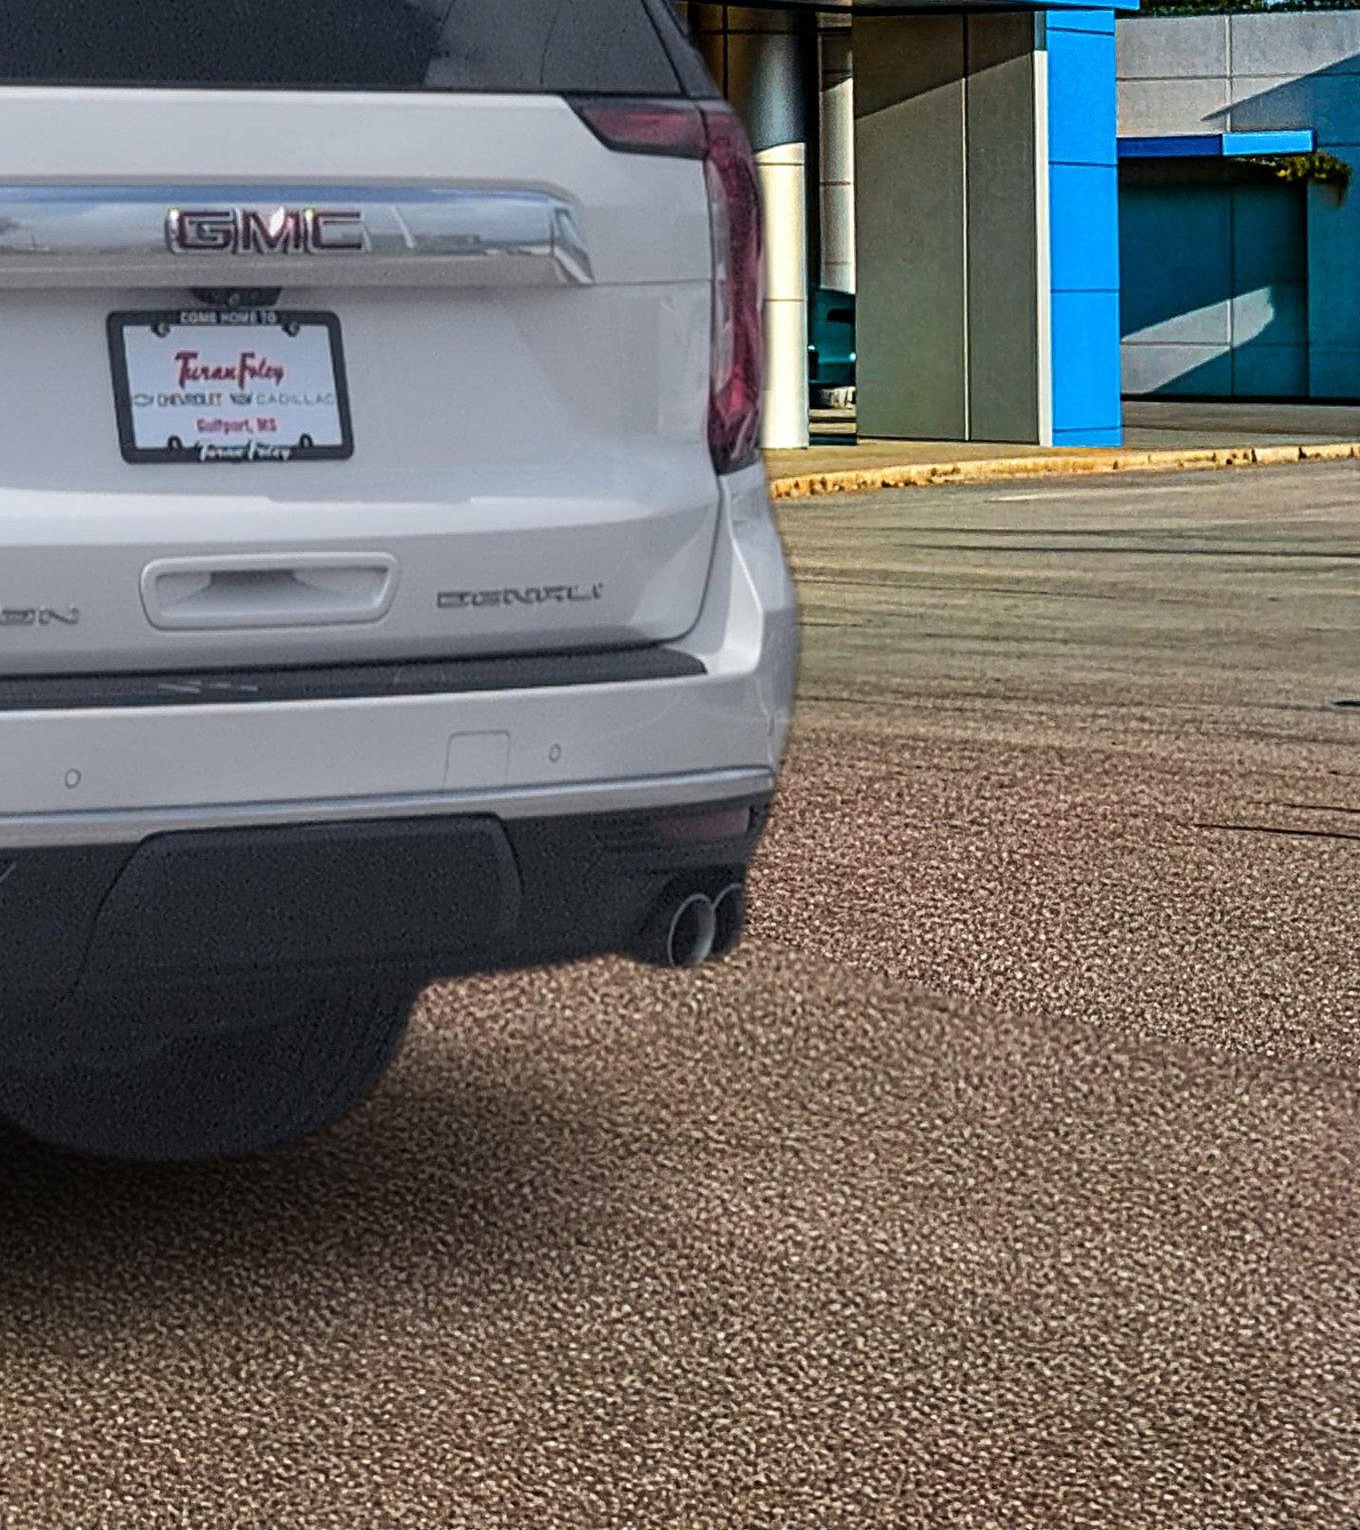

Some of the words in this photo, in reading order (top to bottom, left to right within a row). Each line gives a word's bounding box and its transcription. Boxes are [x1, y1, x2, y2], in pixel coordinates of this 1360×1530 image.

[167, 208, 367, 253] GMC
[174, 351, 236, 390] Turan
[237, 352, 285, 390] Foley
[257, 393, 334, 406] CADILLAC
